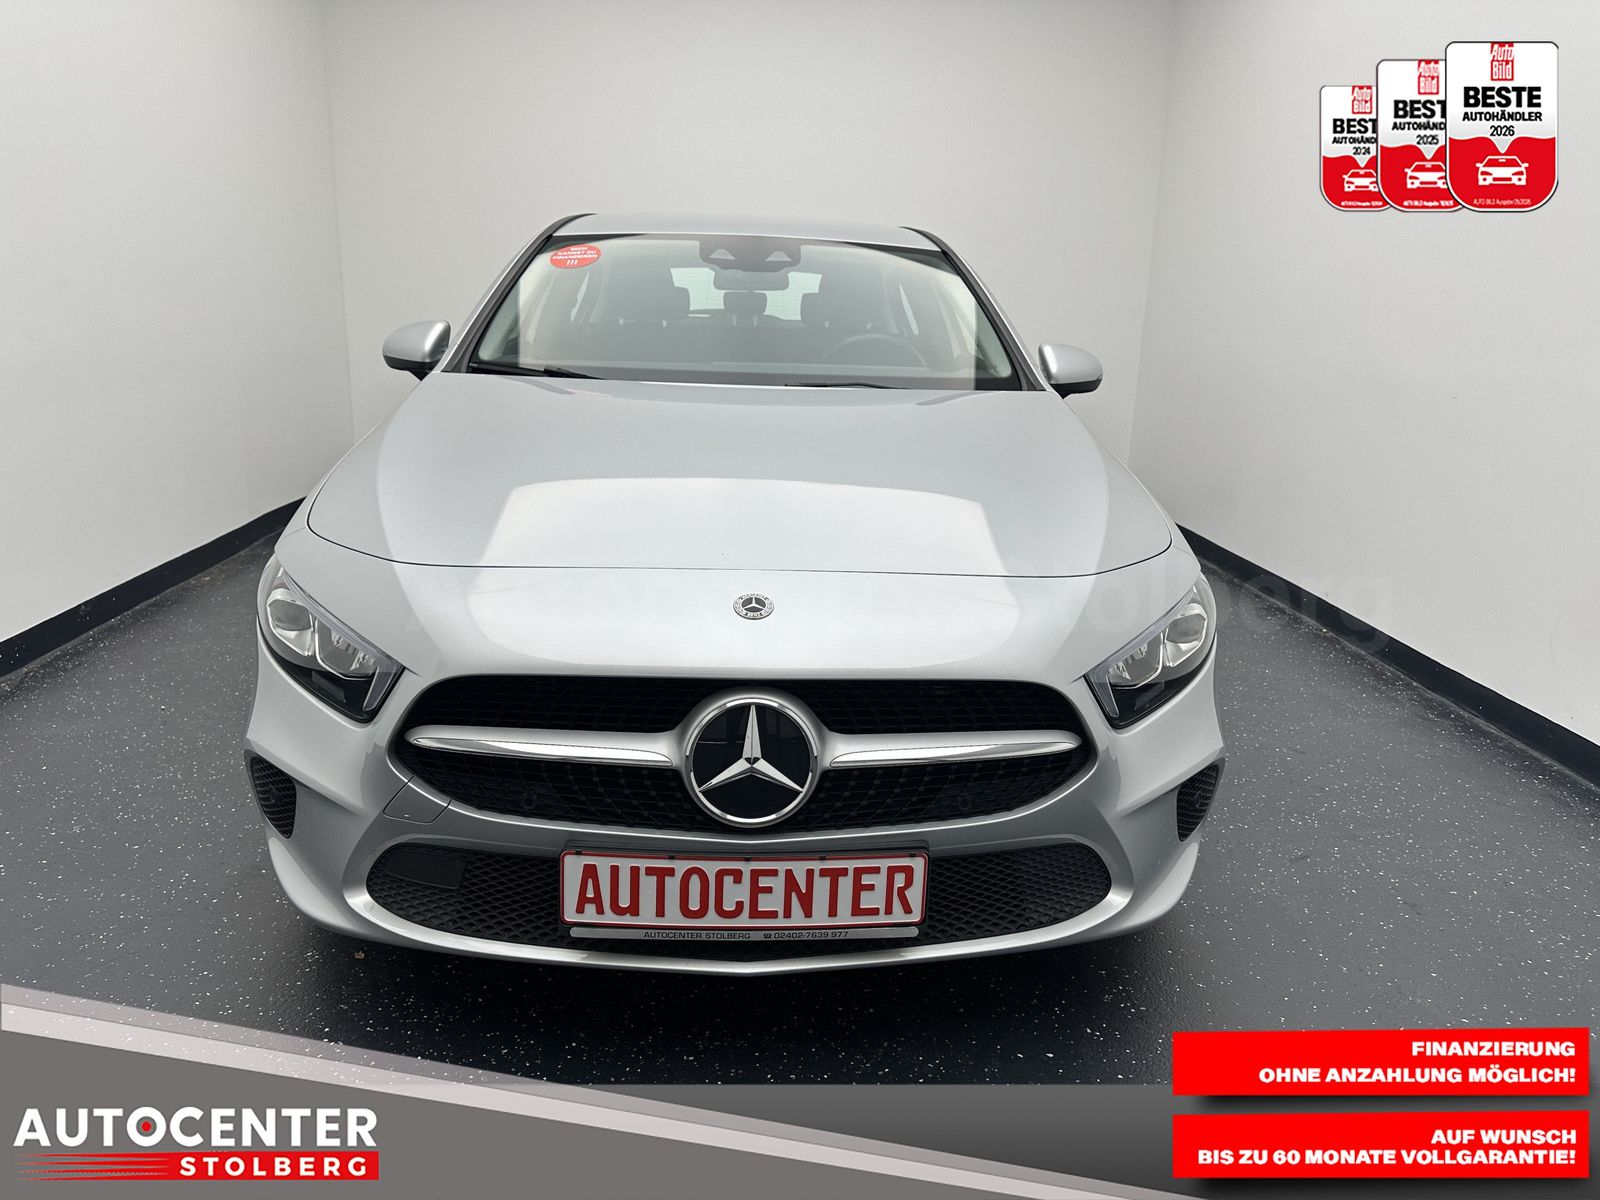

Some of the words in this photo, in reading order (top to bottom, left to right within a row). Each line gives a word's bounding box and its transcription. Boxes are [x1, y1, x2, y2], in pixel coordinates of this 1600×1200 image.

[575, 863, 915, 919] AUTOCENTER
[643, 931, 702, 939] AUTOCENTER
[705, 932, 751, 940] STOLBERG
[773, 931, 829, 939] 02402-7639
[830, 931, 849, 939] 977
